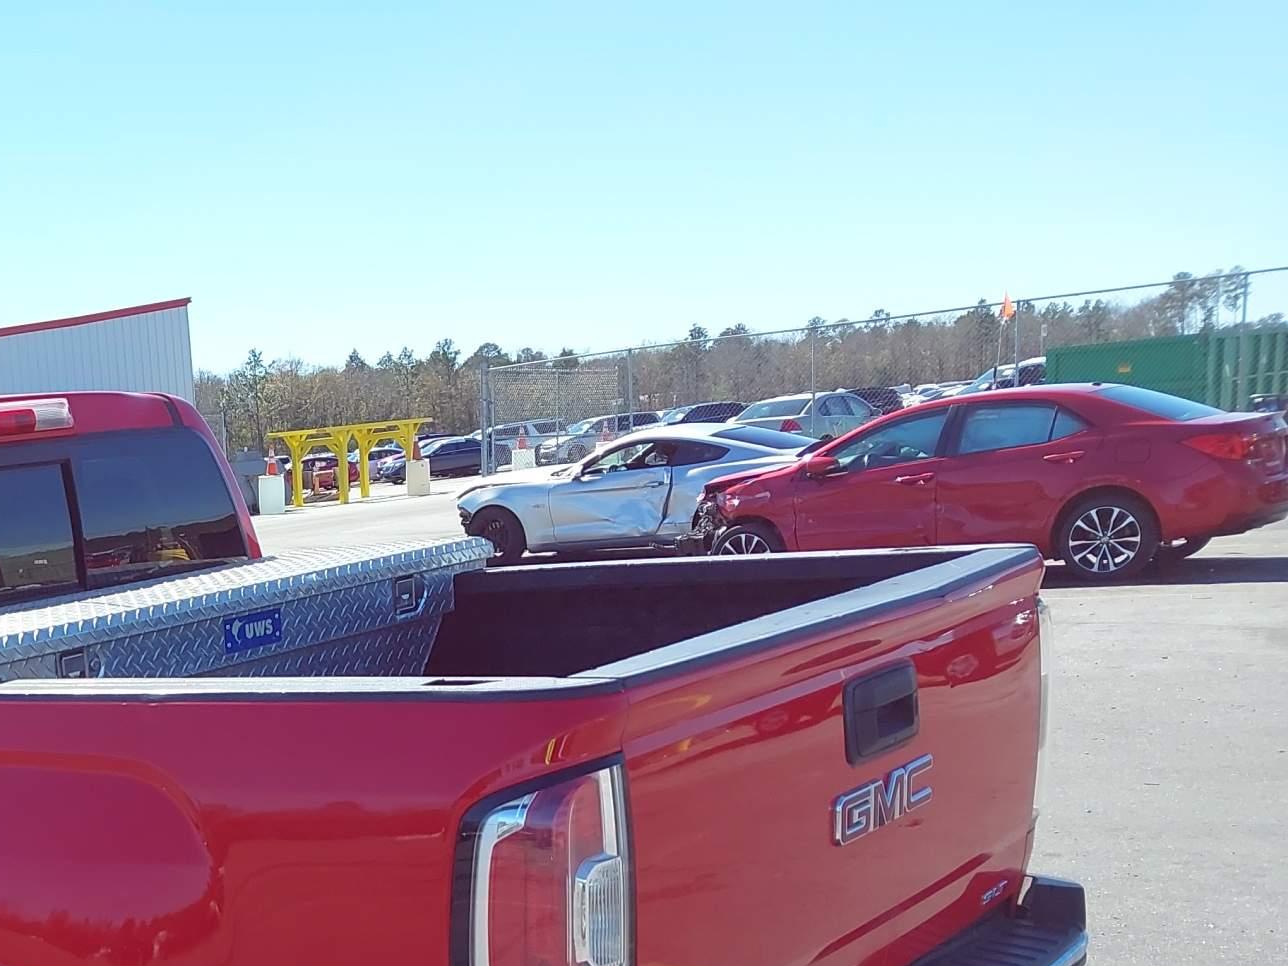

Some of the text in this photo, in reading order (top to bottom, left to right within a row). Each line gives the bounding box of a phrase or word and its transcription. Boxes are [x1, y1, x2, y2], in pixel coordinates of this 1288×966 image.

[245, 618, 273, 639] UWS
[835, 753, 934, 846] GMC
[983, 880, 1008, 905] SLT
